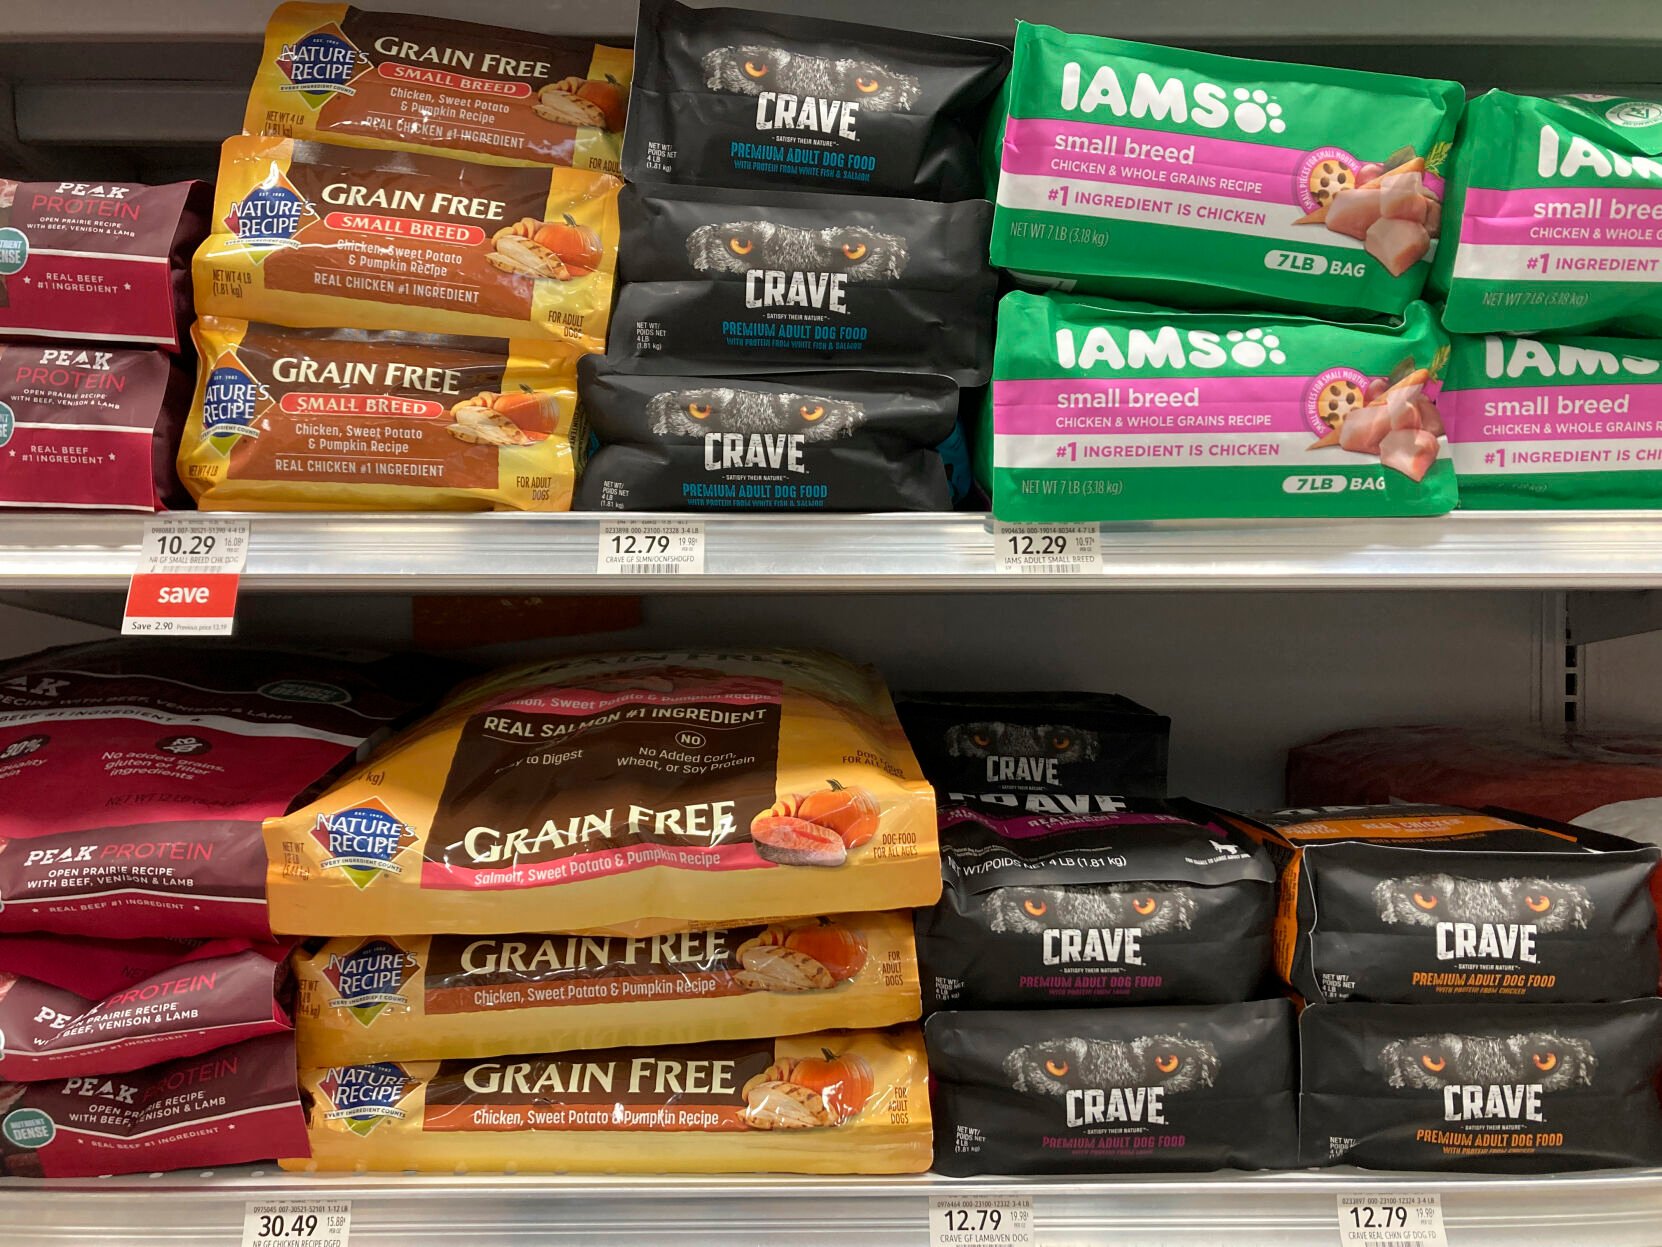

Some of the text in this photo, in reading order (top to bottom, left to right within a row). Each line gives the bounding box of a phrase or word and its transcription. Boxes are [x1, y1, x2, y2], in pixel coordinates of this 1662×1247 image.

[280, 44, 370, 64] NATURE'S
[374, 36, 551, 79] GRAIN FREE
[291, 63, 353, 81] RECIPE
[394, 67, 517, 95] SMALL BREED
[390, 87, 510, 114] Chicken, Sweet Potato
[1061, 61, 1230, 129] IAMS
[401, 101, 496, 124] & Pumpkin Recipe
[756, 91, 860, 140] CRAVE
[730, 142, 876, 171] PREMIUM ADULT DOG FOOD
[1054, 134, 1195, 165] small breed
[1051, 159, 1263, 194] CHICKEN & WHOLE GRAINS RECIPE
[55, 182, 129, 199] PEAK
[322, 183, 505, 220] GRAIN FREE
[32, 195, 141, 220] PROTEIN
[229, 200, 318, 218] NATURE'S
[1048, 185, 1266, 226] #1 INGREDIENT IS CHICKEN
[1534, 198, 1601, 218] small
[239, 218, 298, 238] RECIPE
[342, 216, 470, 241] SMALL BREED
[1010, 221, 1109, 247] NET WT 7 LB (3.18 kg)
[1277, 253, 1366, 277] 7LB BAG
[1527, 253, 1660, 273] #1 INGREDIENT
[46, 273, 104, 283] REAL BEEF
[52, 283, 118, 294] INGREDIENT
[746, 269, 851, 314] CRAVE
[549, 311, 584, 327] FOR ADULT
[722, 321, 867, 341] PREMIUM ADULT DOG FOOD
[1056, 326, 1227, 369] IAMS
[40, 350, 113, 370] PEAK
[16, 367, 126, 392] PROTEIN
[272, 357, 460, 395] GRAIN FREE
[297, 397, 427, 415] SMALL BREED
[1057, 387, 1199, 408] small breed
[1484, 394, 1630, 416] small breed
[1484, 421, 1653, 435] CHICKEN & WHOLE GRAINS
[704, 432, 807, 473] CRAVE
[1056, 442, 1280, 461] #1 INGREDIENT IS CHICKEN
[682, 483, 828, 498] PREMIUM ADULT DOG FOOD
[1297, 477, 1386, 490] 7LB BAG
[157, 536, 216, 554] 10.29
[612, 535, 670, 554] 12.79
[1008, 535, 1067, 554] 12.29
[157, 587, 209, 603] save
[132, 621, 173, 630] Save 2.90
[484, 707, 767, 738] REAL SALMON #1 INGREDIENT
[986, 756, 1061, 785] CRAVE
[316, 813, 416, 837] NATURE'S
[463, 800, 736, 862] GRAIN FREE
[330, 834, 398, 855] RECIPE
[882, 832, 916, 845] DOG FOOD
[24, 842, 214, 866] PEAK PROTEIN
[528, 865, 568, 882] Sweet
[570, 855, 612, 875] Potato
[615, 852, 624, 866] &
[627, 847, 677, 863] Pumpkin
[680, 850, 721, 866] Recipe
[49, 865, 174, 877] OPEN PRAIRIE RECIPE
[461, 930, 729, 974] GRAIN FREE
[1043, 928, 1147, 966] CRAVE
[1436, 921, 1540, 964] CRAVE
[1020, 976, 1162, 988] PREMIUM ADULT DOG FOOD
[1412, 972, 1555, 988] PREMIUM ADULT DOG FOOD
[464, 1057, 736, 1095] GRAIN FREE
[62, 1077, 138, 1104] PEAK
[1066, 1087, 1168, 1127] CRAVE
[1443, 1084, 1546, 1121] CRAVE
[891, 1113, 909, 1124] DOGS
[13, 1129, 49, 1140] DENSE
[1416, 1130, 1564, 1147] PREMIUM ADULT DOG FOOD
[257, 1214, 318, 1237] 30.49
[944, 1209, 1002, 1231] 12.79
[1350, 1206, 1408, 1228] 12.79
